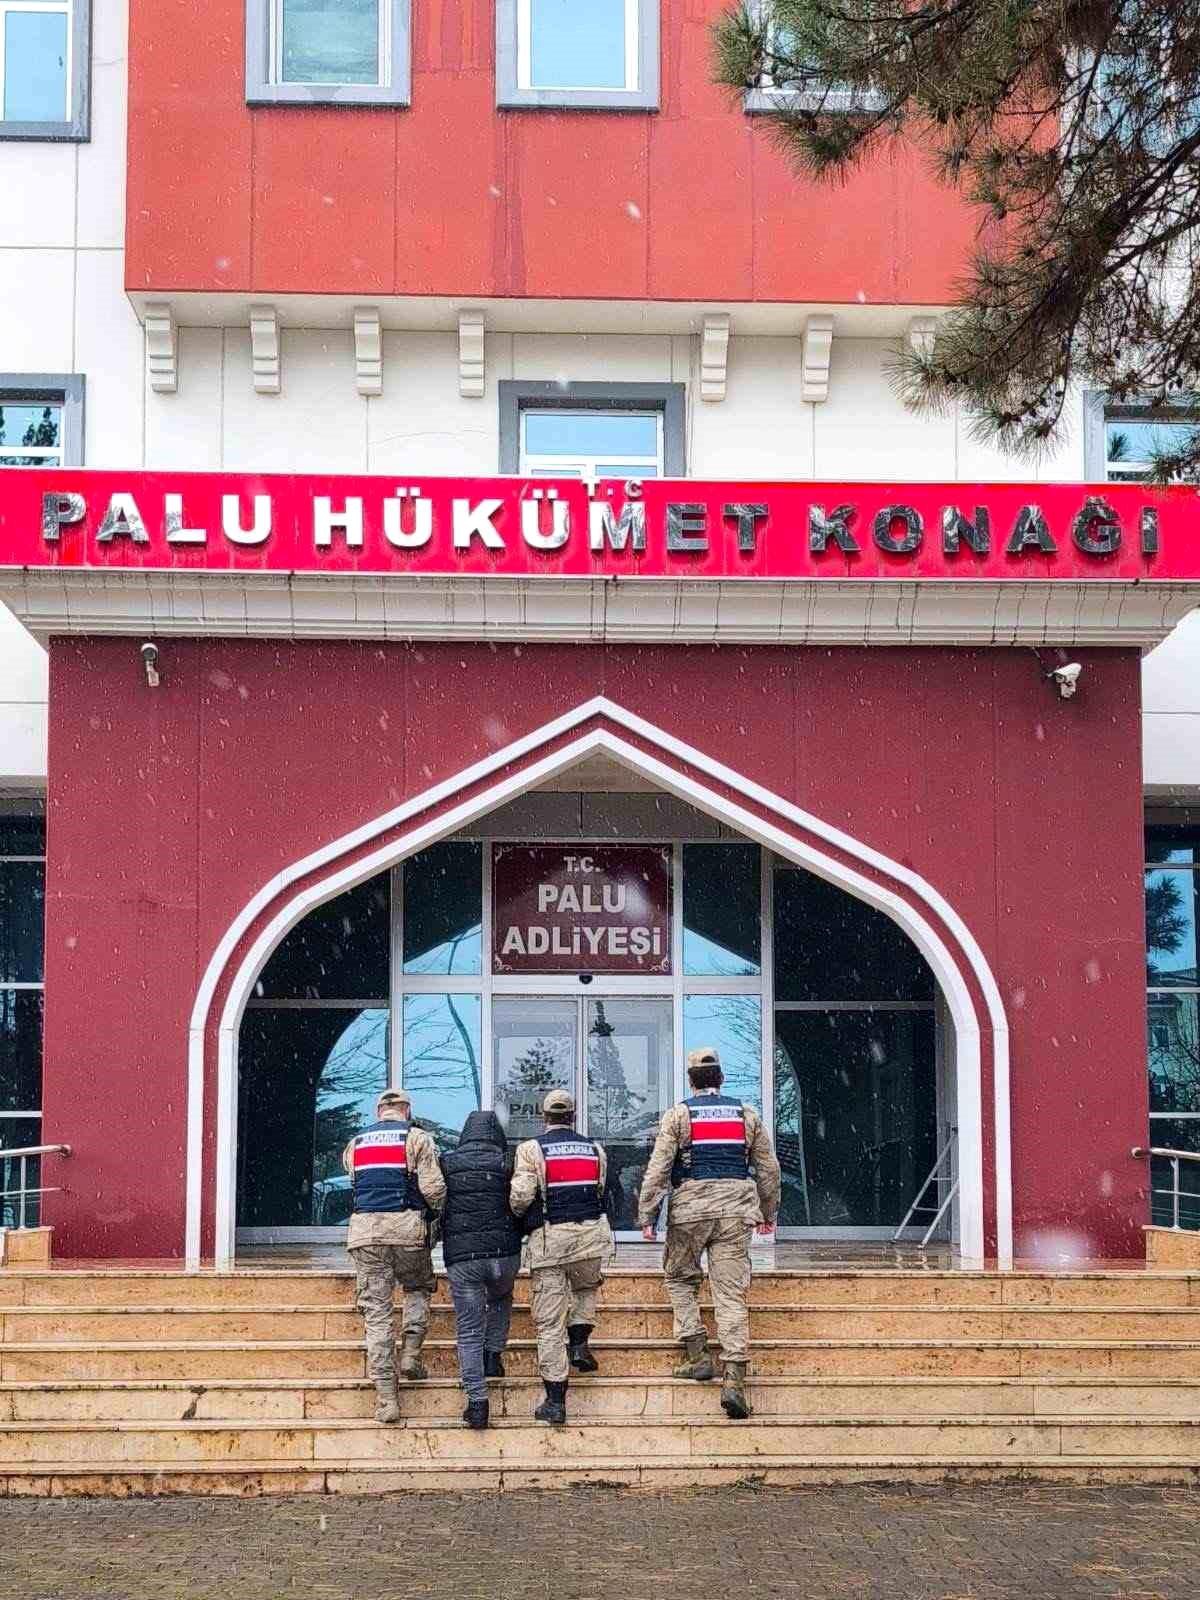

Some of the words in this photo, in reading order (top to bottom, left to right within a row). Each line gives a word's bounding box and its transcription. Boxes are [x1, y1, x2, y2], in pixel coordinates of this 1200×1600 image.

[42, 492, 273, 546] PALU
[314, 487, 769, 553] HÜKÜMET
[808, 495, 1160, 554] KONAĞI
[563, 856, 600, 873] T.C.
[538, 884, 626, 913] PALU
[509, 1103, 543, 1115] PAL
